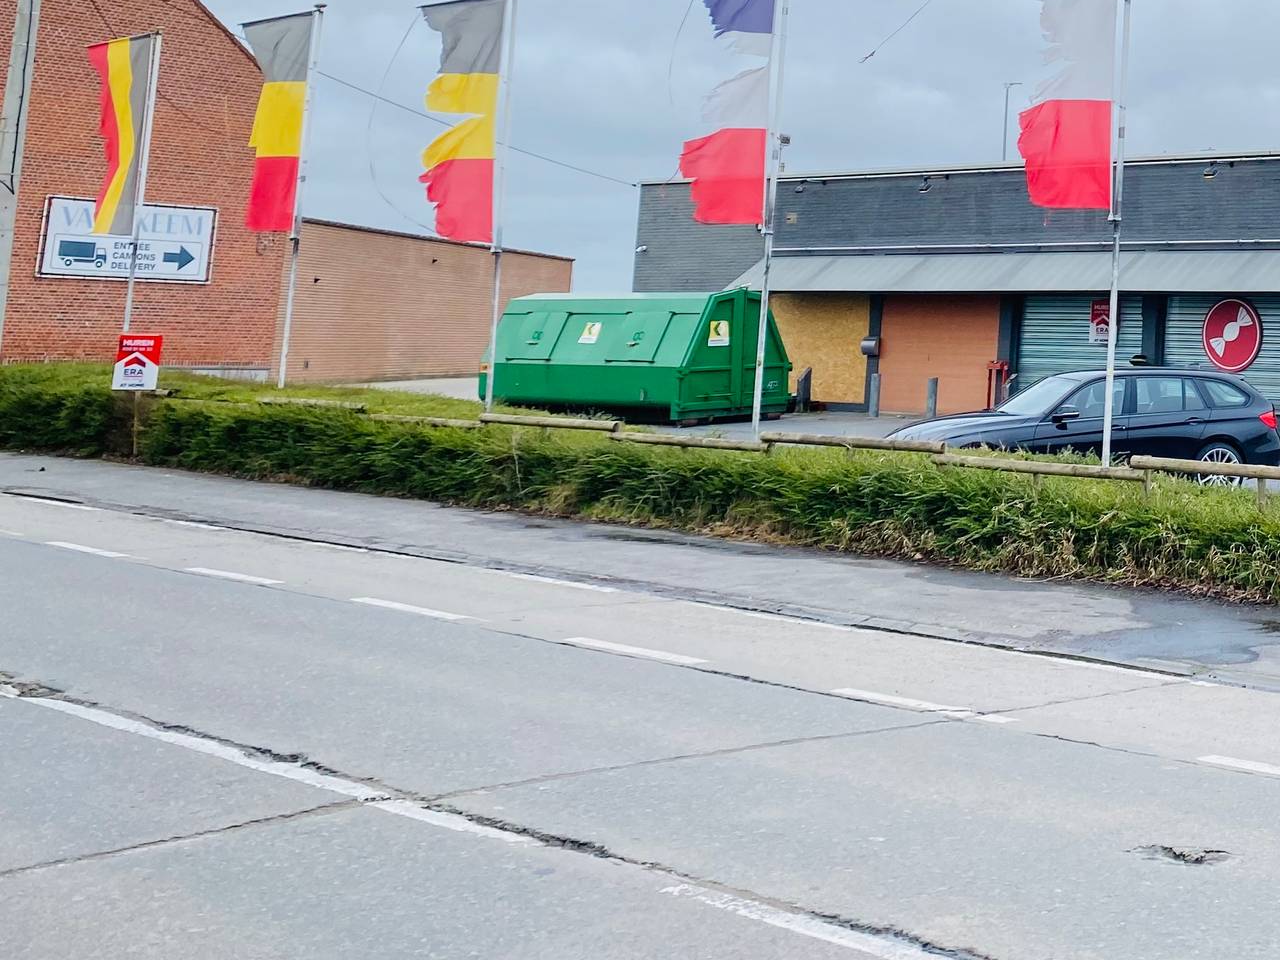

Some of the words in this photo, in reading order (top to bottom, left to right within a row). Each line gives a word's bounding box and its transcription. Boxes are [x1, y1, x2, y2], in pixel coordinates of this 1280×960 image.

[114, 242, 151, 251] ENTEE
[112, 252, 156, 261] CAMONS
[111, 261, 156, 271] DELVERY
[123, 368, 144, 376] ERA
